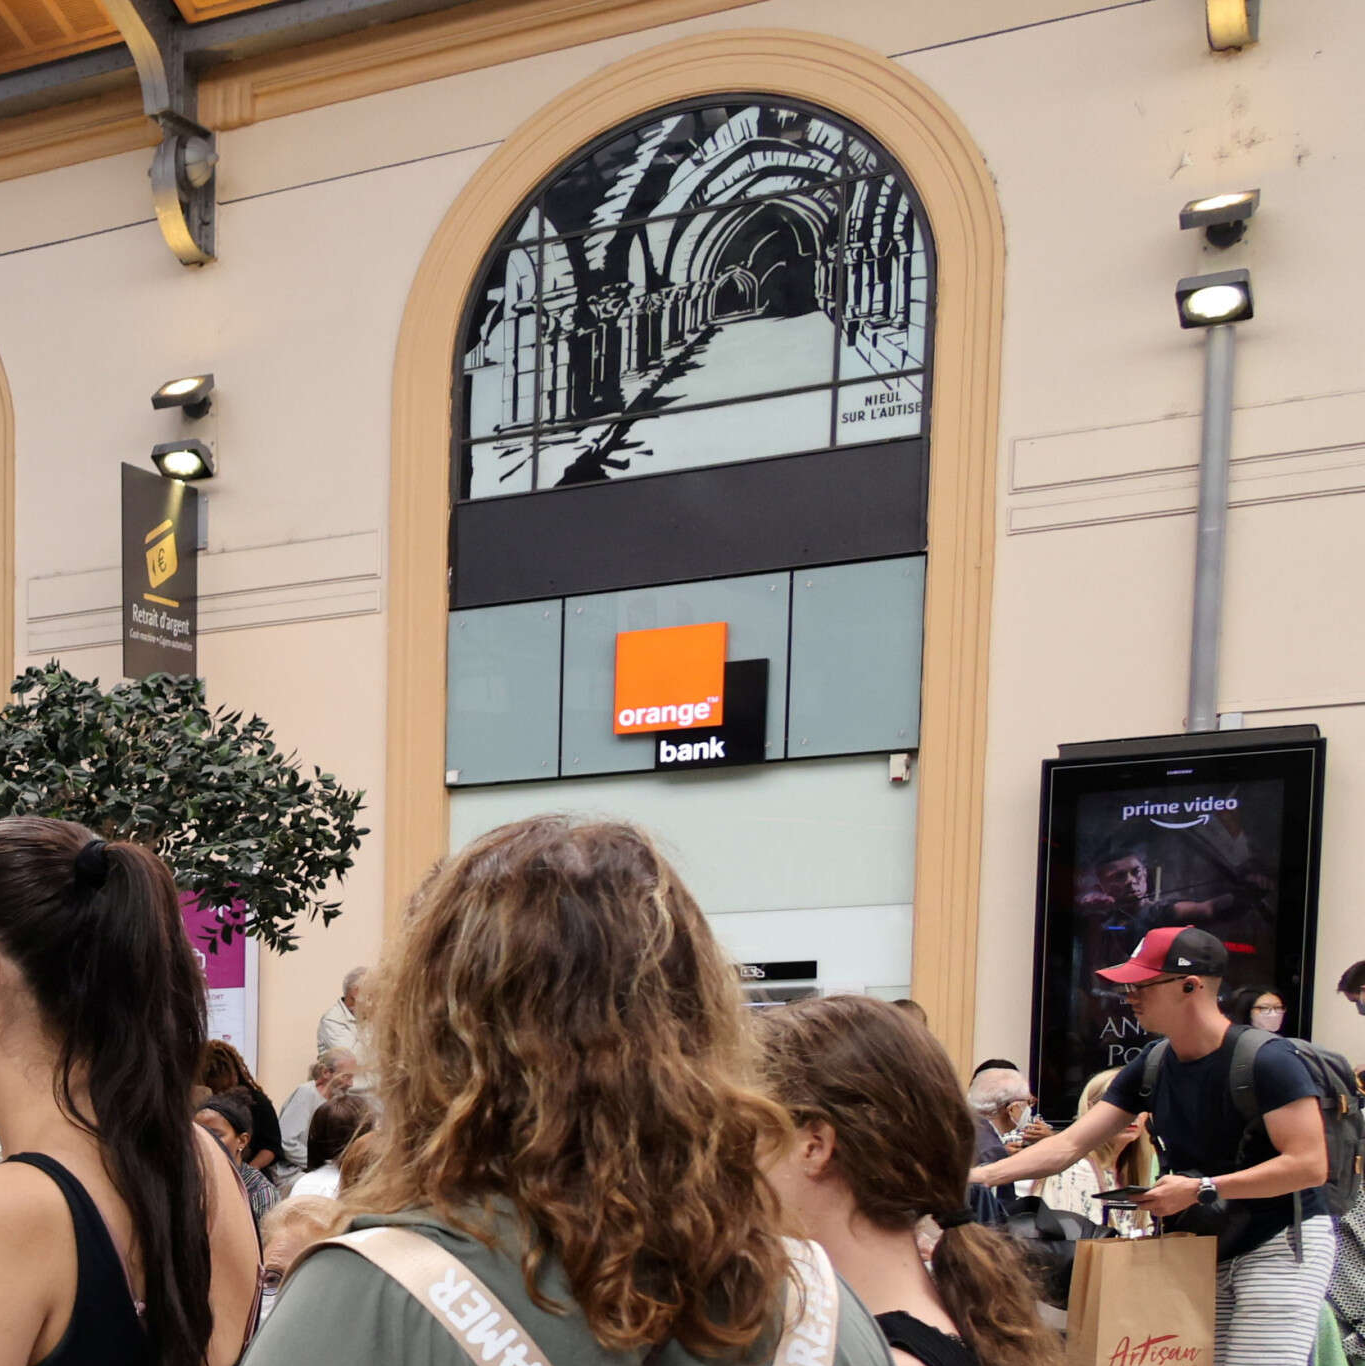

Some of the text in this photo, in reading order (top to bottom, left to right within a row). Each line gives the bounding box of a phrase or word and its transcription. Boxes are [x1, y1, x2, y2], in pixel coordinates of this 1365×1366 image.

[864, 391, 902, 407] NIEUL
[841, 401, 922, 424] SUR L'AUTISE
[618, 701, 711, 727] orange
[659, 736, 726, 763] bank
[1123, 796, 1239, 821] prime video
